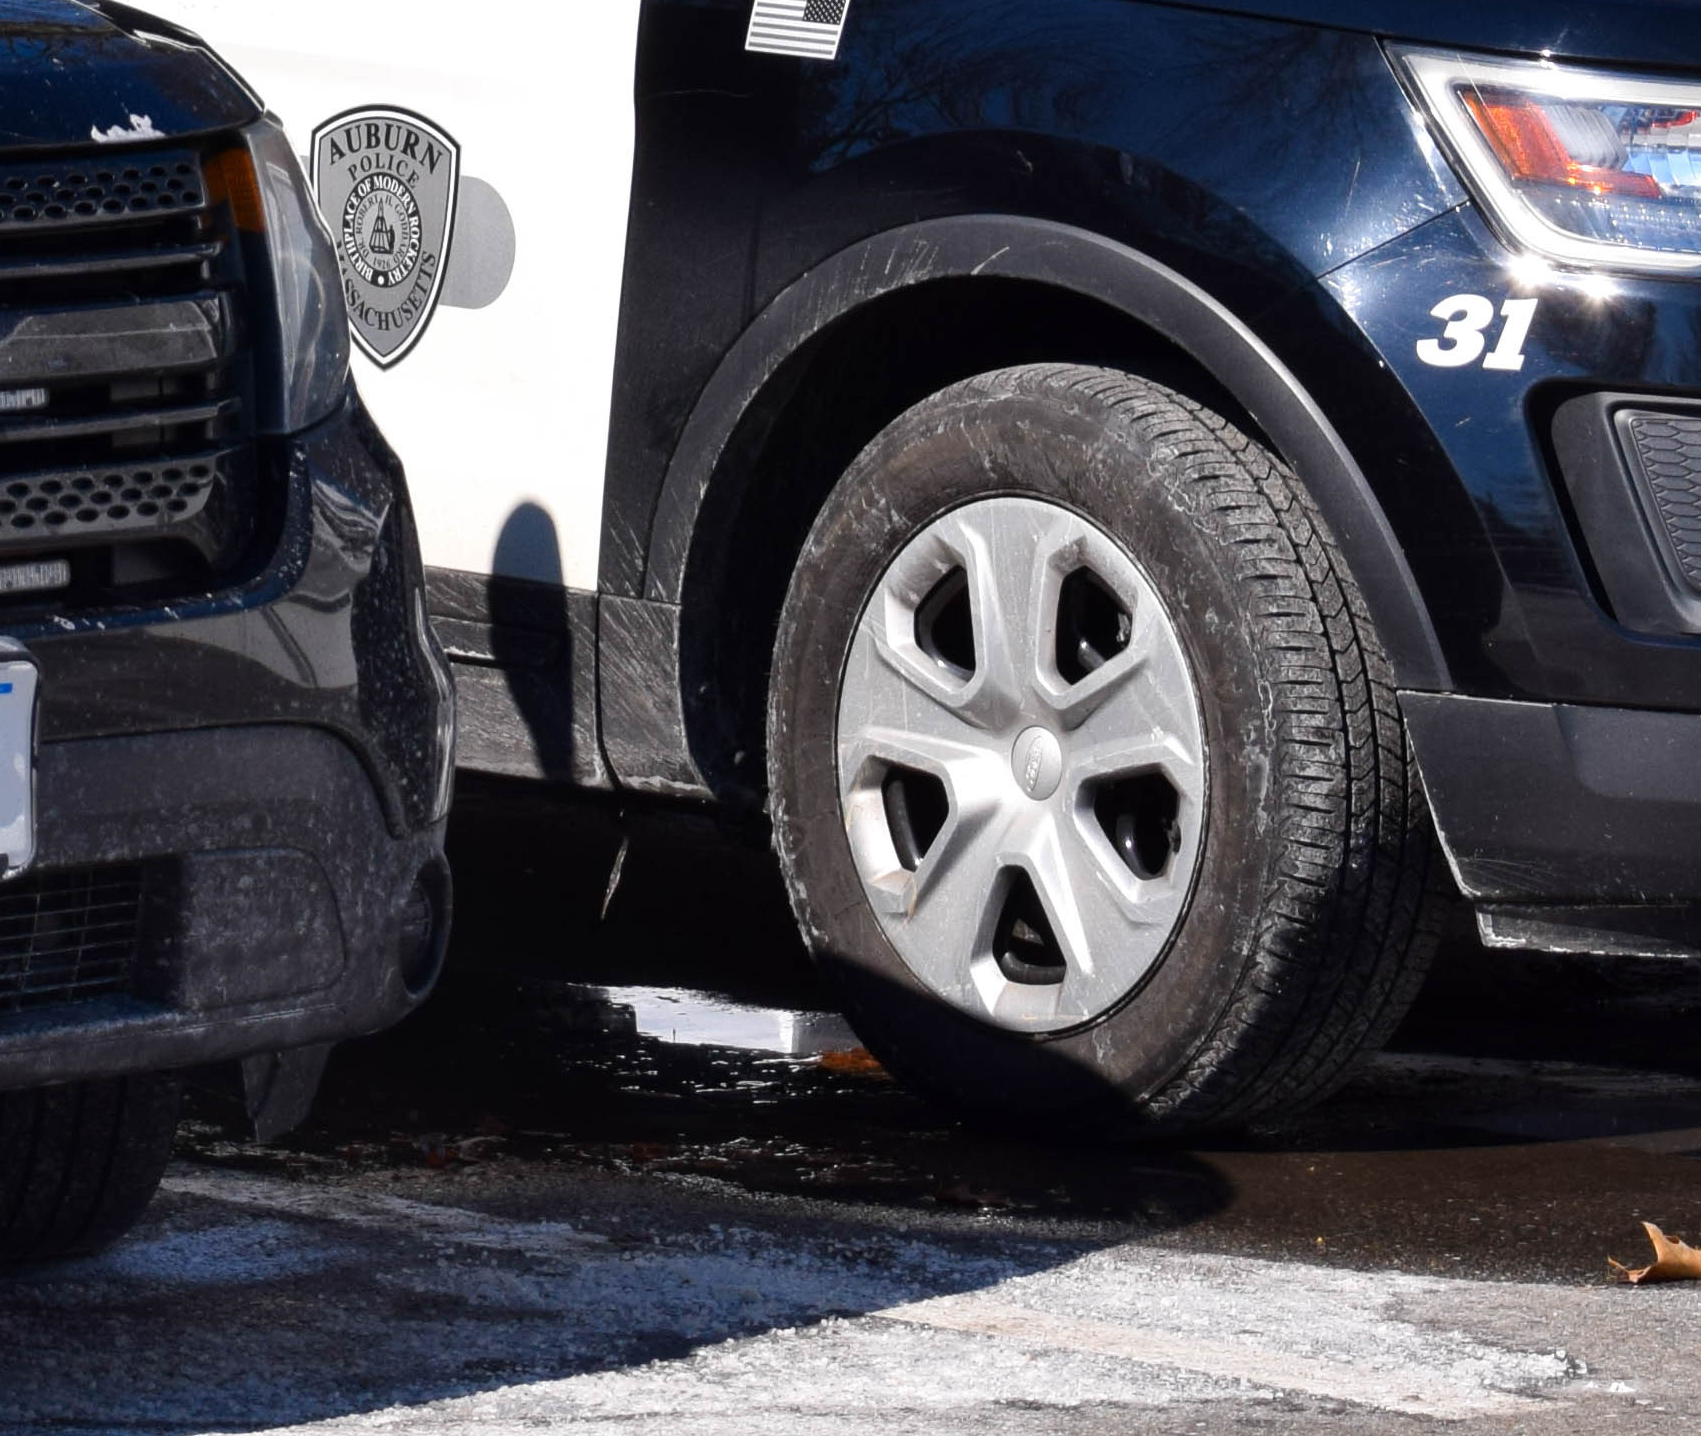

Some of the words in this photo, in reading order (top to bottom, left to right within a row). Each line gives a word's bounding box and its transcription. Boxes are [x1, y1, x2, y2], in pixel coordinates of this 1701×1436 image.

[329, 122, 444, 176] AUBURN
[348, 152, 420, 189] POLICE
[358, 178, 373, 198] OF
[373, 175, 417, 215] MODERN
[344, 192, 374, 282] BIRTHPLACE
[387, 216, 421, 286] ROCKETRY
[1416, 294, 1538, 371] 31
